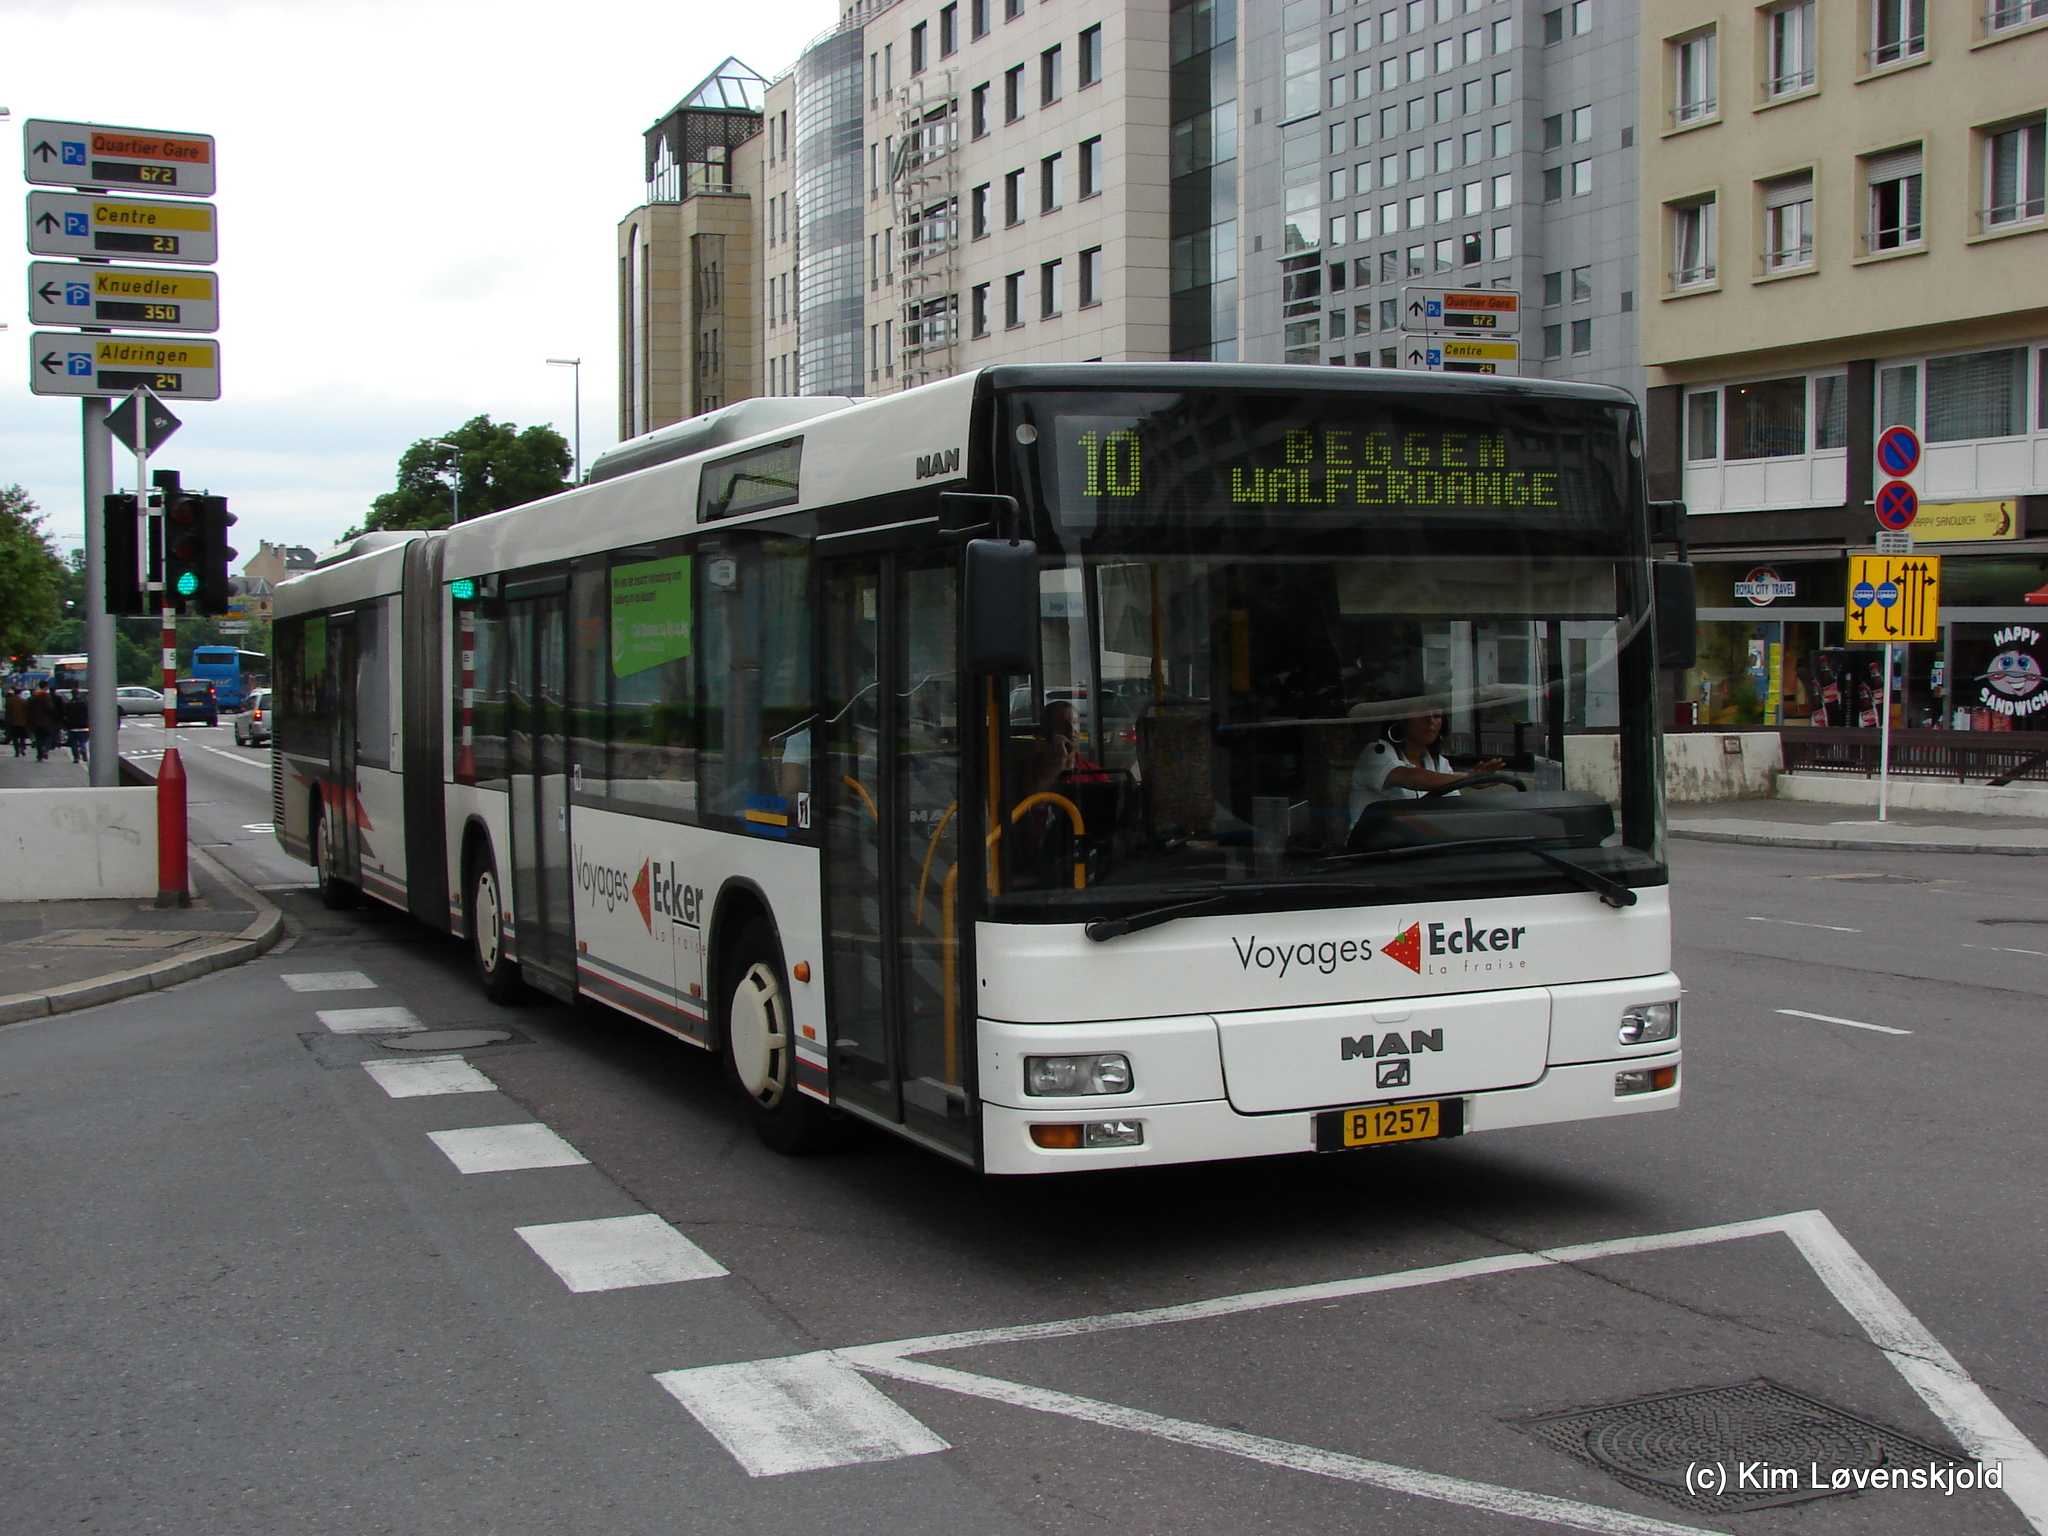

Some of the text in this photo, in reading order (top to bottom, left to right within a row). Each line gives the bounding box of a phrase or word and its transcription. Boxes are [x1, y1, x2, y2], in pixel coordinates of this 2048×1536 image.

[93, 136, 157, 155] Quartier
[163, 141, 199, 159] Gare
[140, 167, 172, 182] 672
[96, 207, 156, 224] Centre
[153, 236, 174, 251] 23
[98, 277, 178, 296] Knuedler
[1446, 296, 1485, 307] Quartier
[1489, 298, 1511, 309] Gare
[145, 305, 176, 321] 350
[1473, 315, 1493, 326] 672
[100, 344, 187, 365] Aldringen
[1445, 344, 1482, 356] Centre
[156, 373, 177, 388] 24
[1285, 429, 1505, 467] BEGGEN
[916, 448, 959, 480] MAN
[1077, 430, 1141, 497] 10
[1232, 467, 1558, 506] WALFERDANGE
[1936, 515, 1975, 527] SANDWICH
[1736, 583, 1794, 595] ROYAL CITY TRAVEL
[1993, 626, 2039, 647] HAPPY
[1979, 687, 2048, 716] SANDWICH
[574, 843, 703, 923] Voyages Ecker
[1232, 917, 1526, 978] Voyages Ecker
[1429, 959, 1526, 975] La fraise
[1341, 1028, 1443, 1060] MAN
[1353, 1107, 1431, 1140] B 1257
